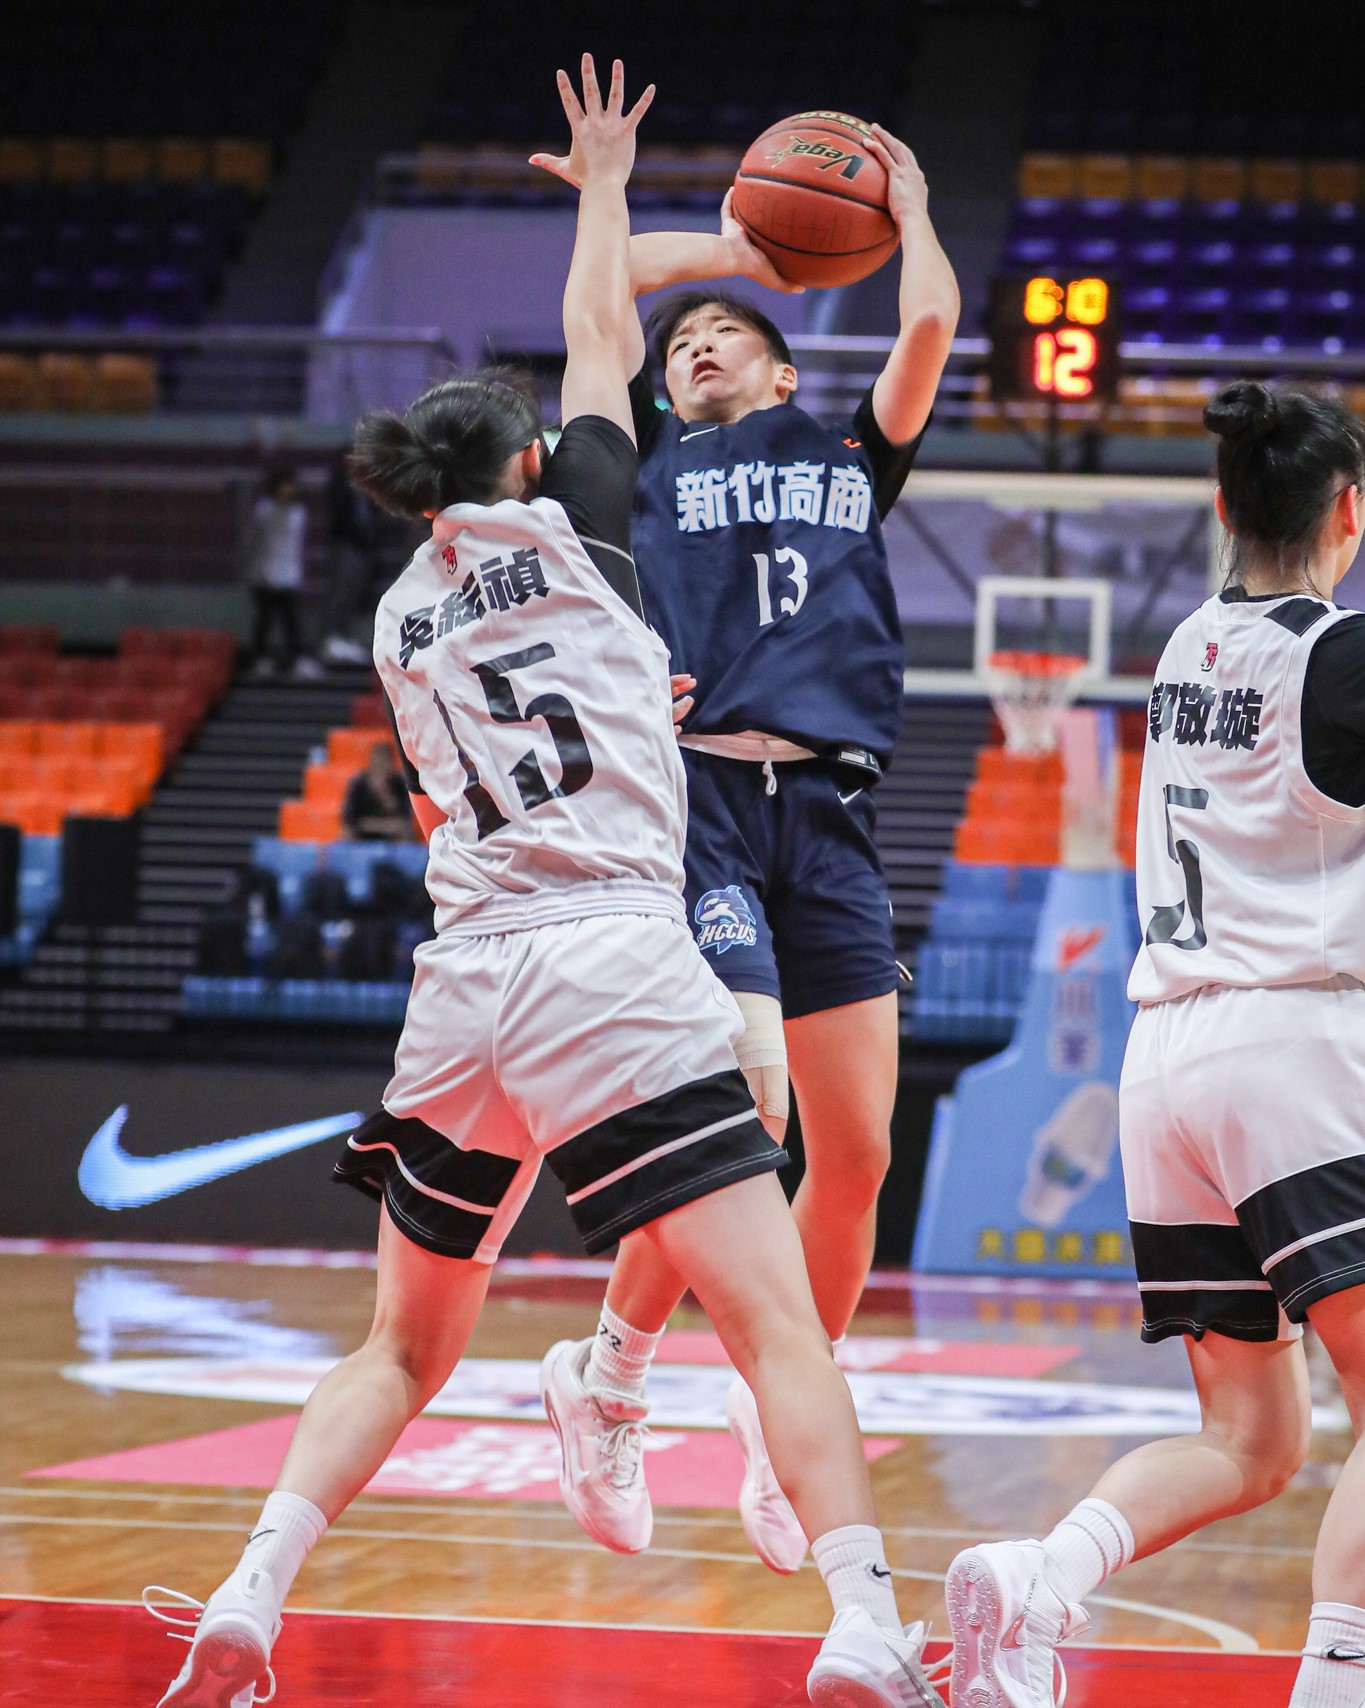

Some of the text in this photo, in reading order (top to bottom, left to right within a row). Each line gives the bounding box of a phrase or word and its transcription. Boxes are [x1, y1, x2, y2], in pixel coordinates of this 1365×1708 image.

[791, 142, 865, 182] Vega
[1034, 328, 1097, 397] 12
[675, 460, 872, 534] 新竹高商
[752, 546, 809, 627] 13
[433, 641, 594, 842] 15
[1146, 783, 1210, 951] 5
